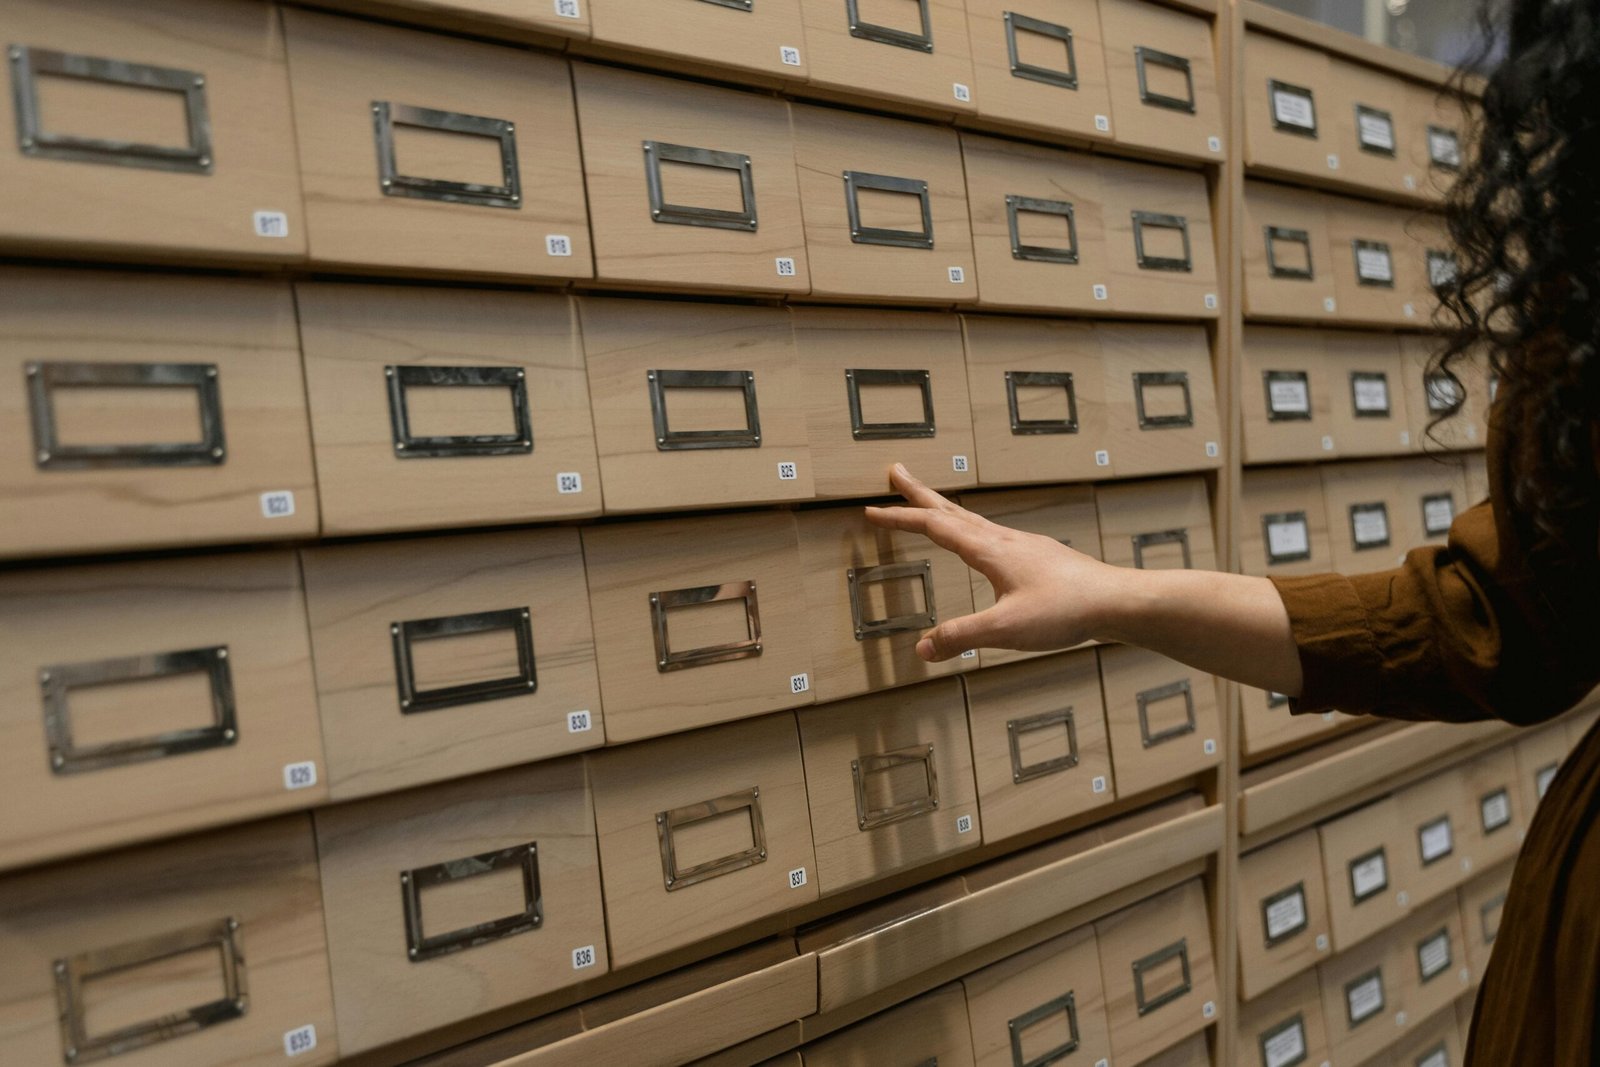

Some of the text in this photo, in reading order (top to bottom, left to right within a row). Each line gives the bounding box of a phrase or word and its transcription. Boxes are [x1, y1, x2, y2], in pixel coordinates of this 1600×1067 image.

[779, 260, 792, 274] 819
[781, 465, 794, 478] 825
[561, 476, 577, 491] 824
[794, 677, 806, 691] 831
[571, 714, 587, 730] 830
[959, 817, 970, 832] 838
[791, 870, 804, 887] 837
[576, 949, 591, 966] 836
[291, 1030, 311, 1051] 835
